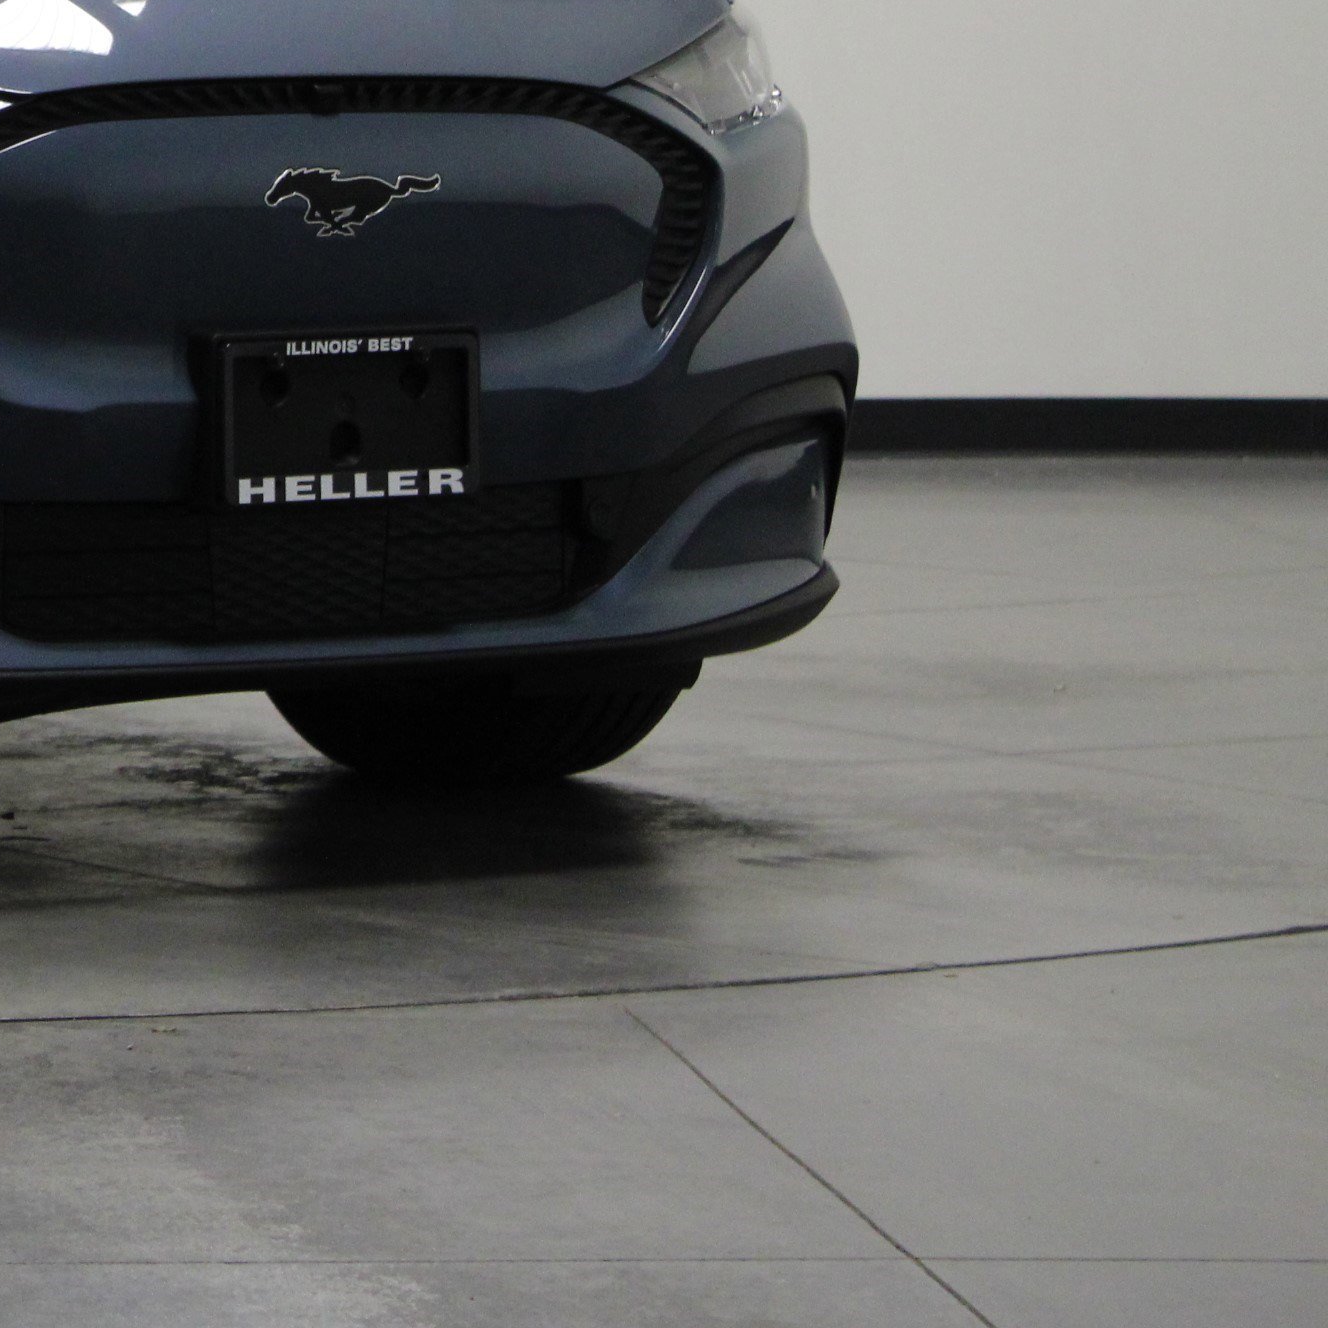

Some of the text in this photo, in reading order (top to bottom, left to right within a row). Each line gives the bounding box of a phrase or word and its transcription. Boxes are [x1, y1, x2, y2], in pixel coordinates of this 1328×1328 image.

[286, 337, 414, 356] ILLINOIS' BEST
[238, 467, 464, 505] HELLER
